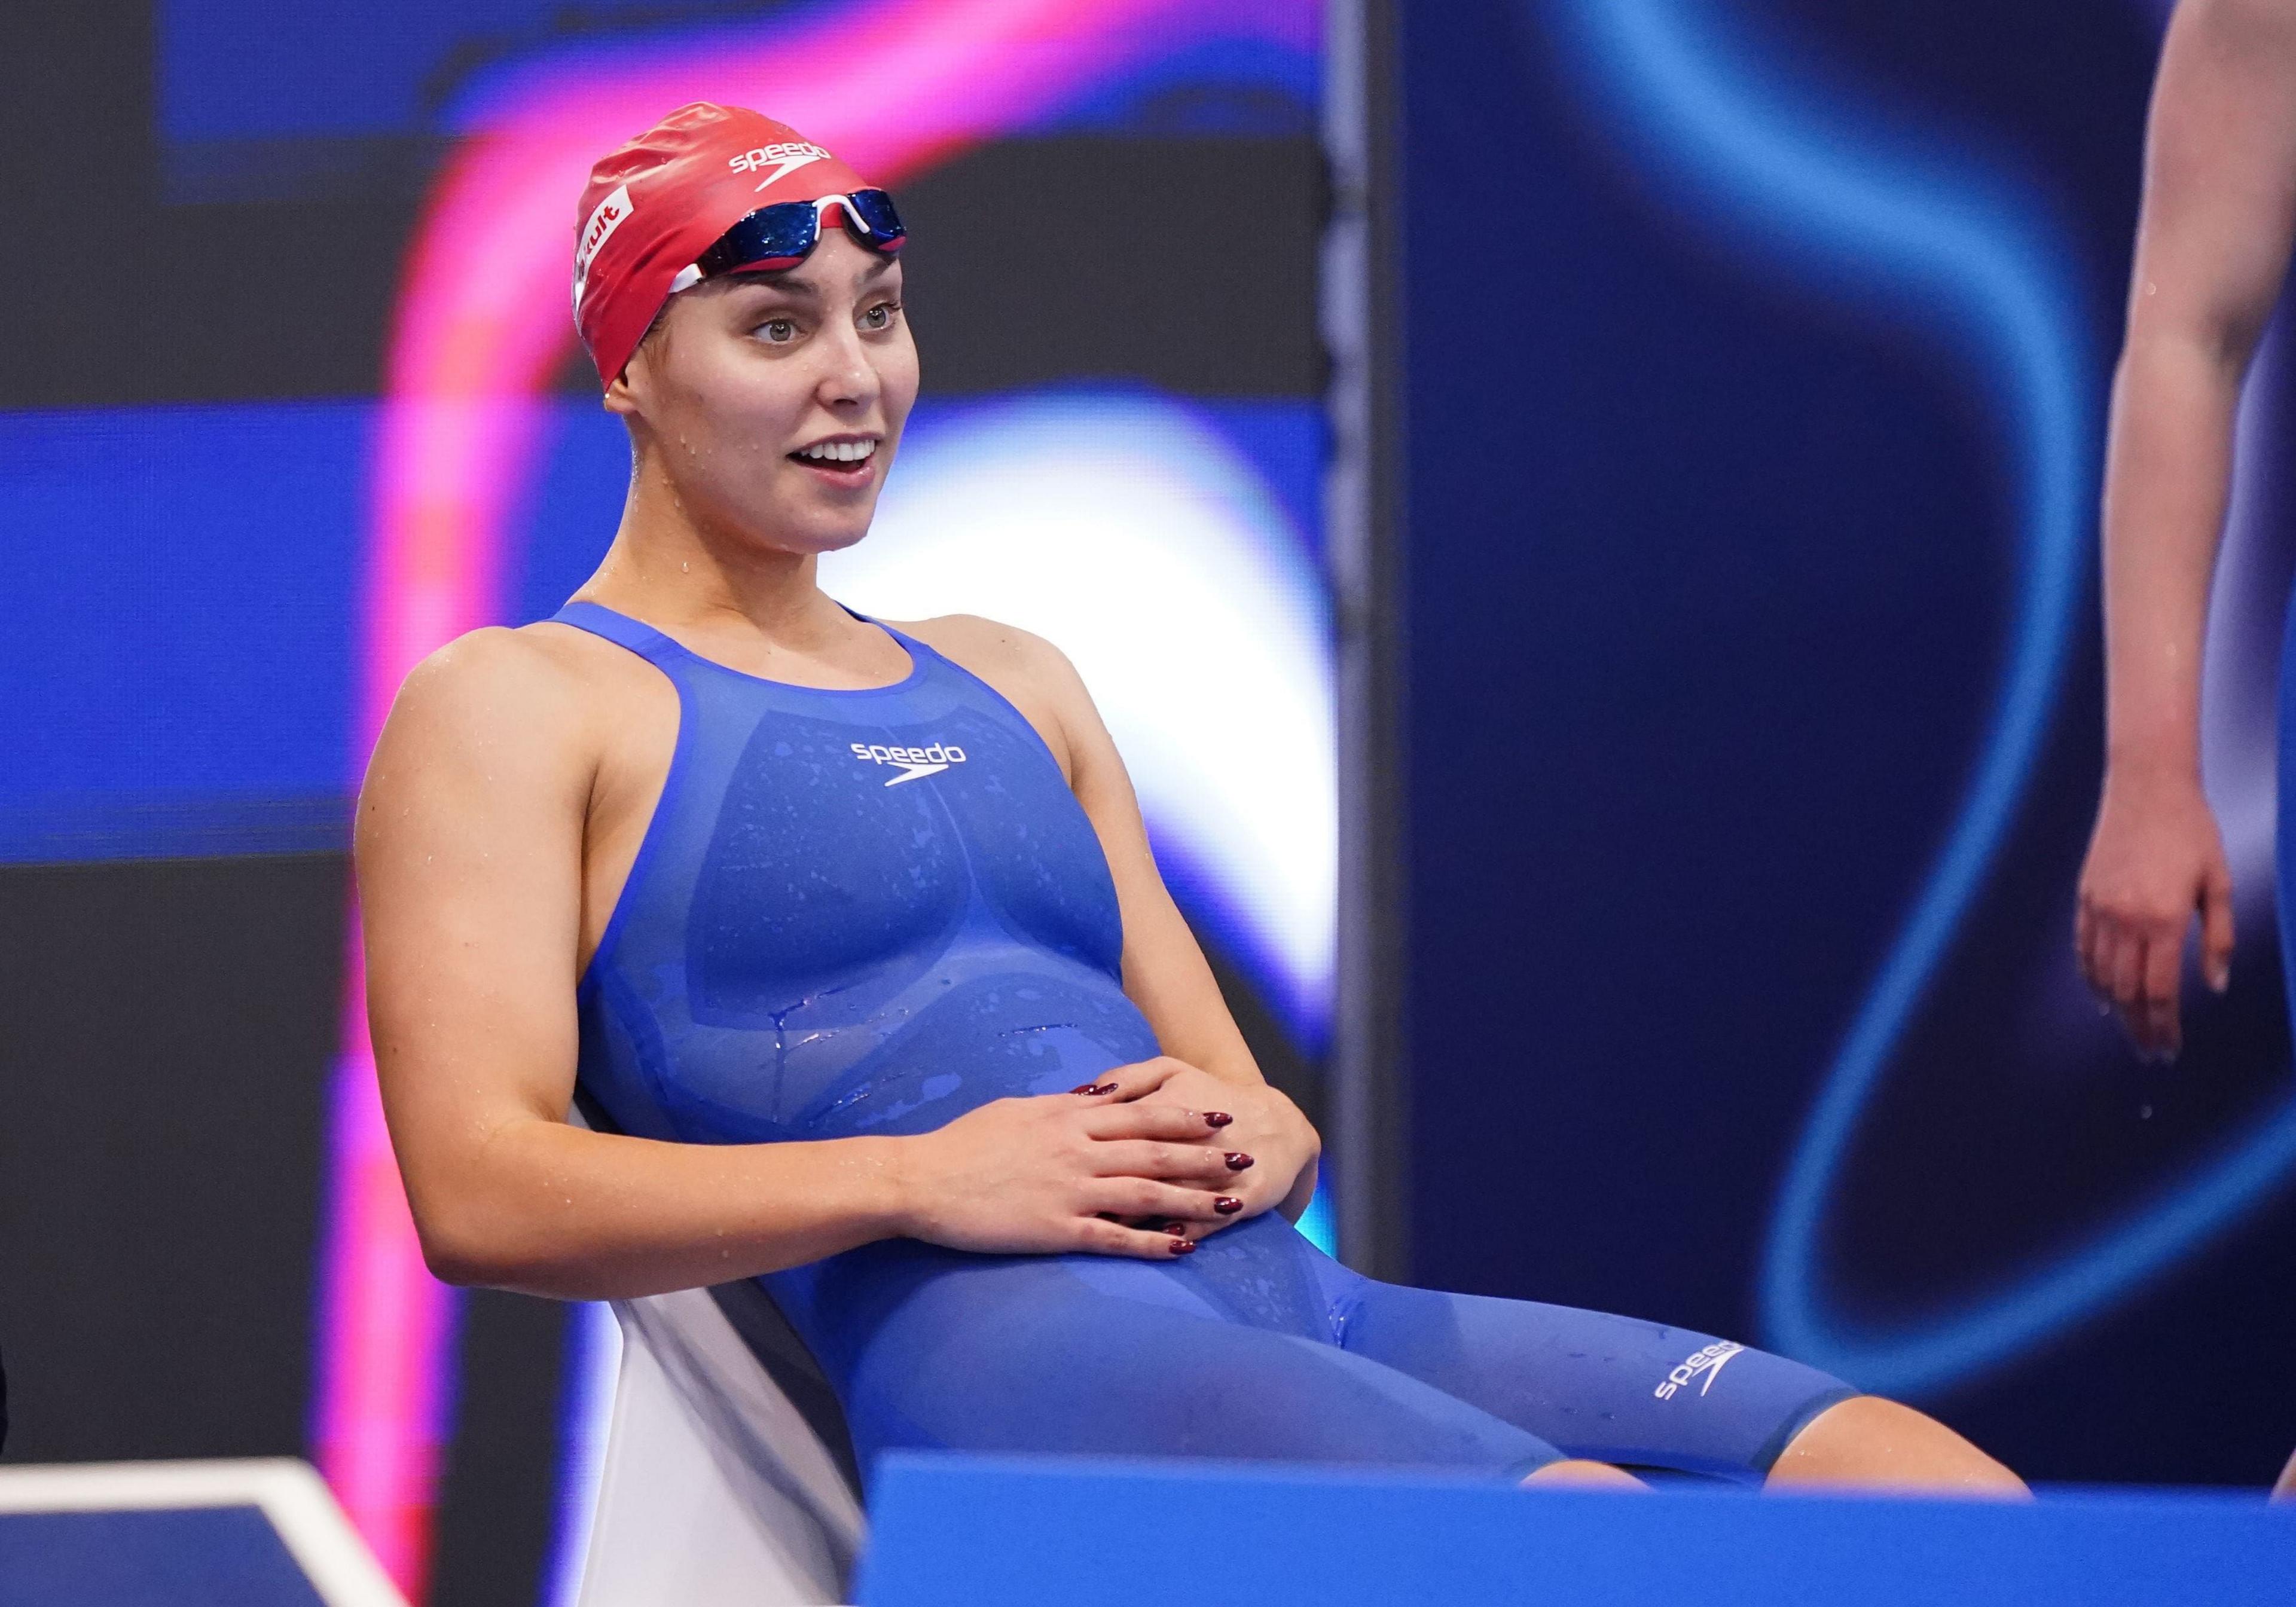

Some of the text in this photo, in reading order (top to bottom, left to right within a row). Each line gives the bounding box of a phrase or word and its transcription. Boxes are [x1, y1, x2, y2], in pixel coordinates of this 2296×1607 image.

[728, 142, 832, 174] speedo
[850, 742, 966, 765] speedo
[1654, 1340, 1743, 1400] speed
